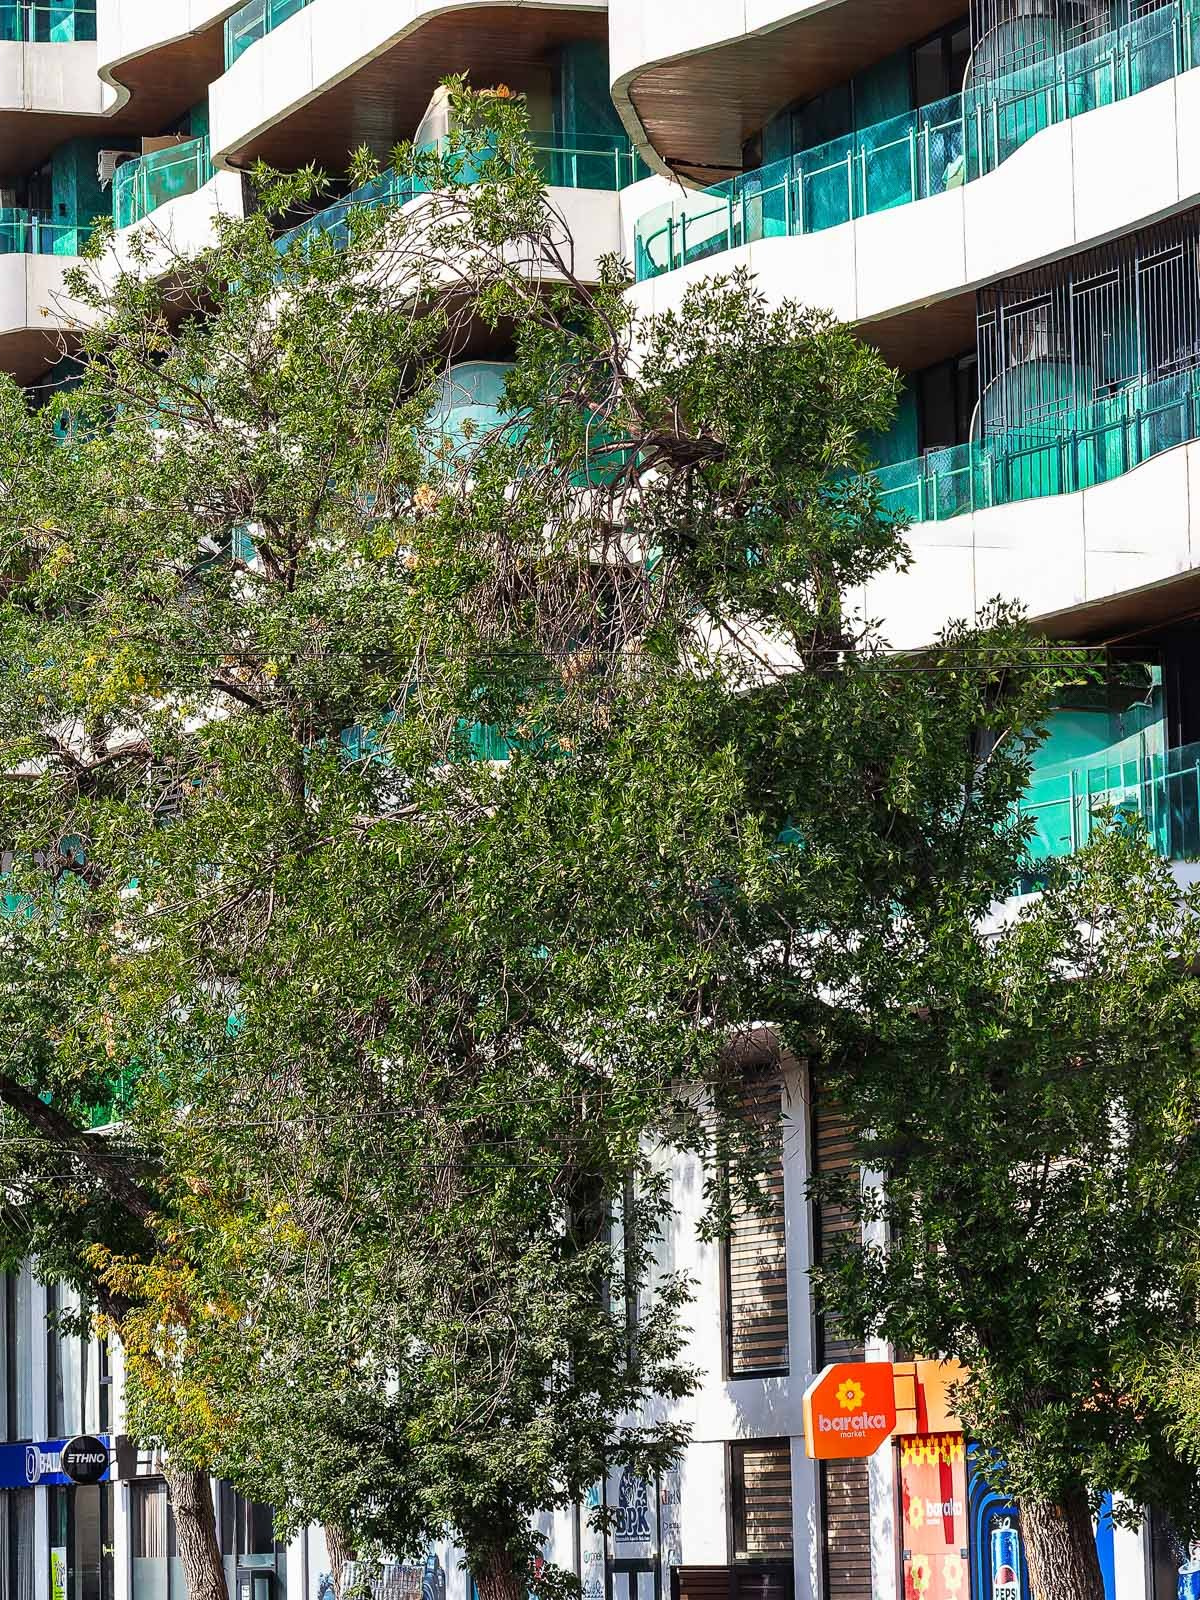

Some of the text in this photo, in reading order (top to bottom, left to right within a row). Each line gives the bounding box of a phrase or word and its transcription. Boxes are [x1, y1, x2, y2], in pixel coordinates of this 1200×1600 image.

[818, 1411, 886, 1432] baraka
[840, 1430, 866, 1439] market
[67, 1453, 105, 1463] ETHNO
[615, 1505, 651, 1535] BPK
